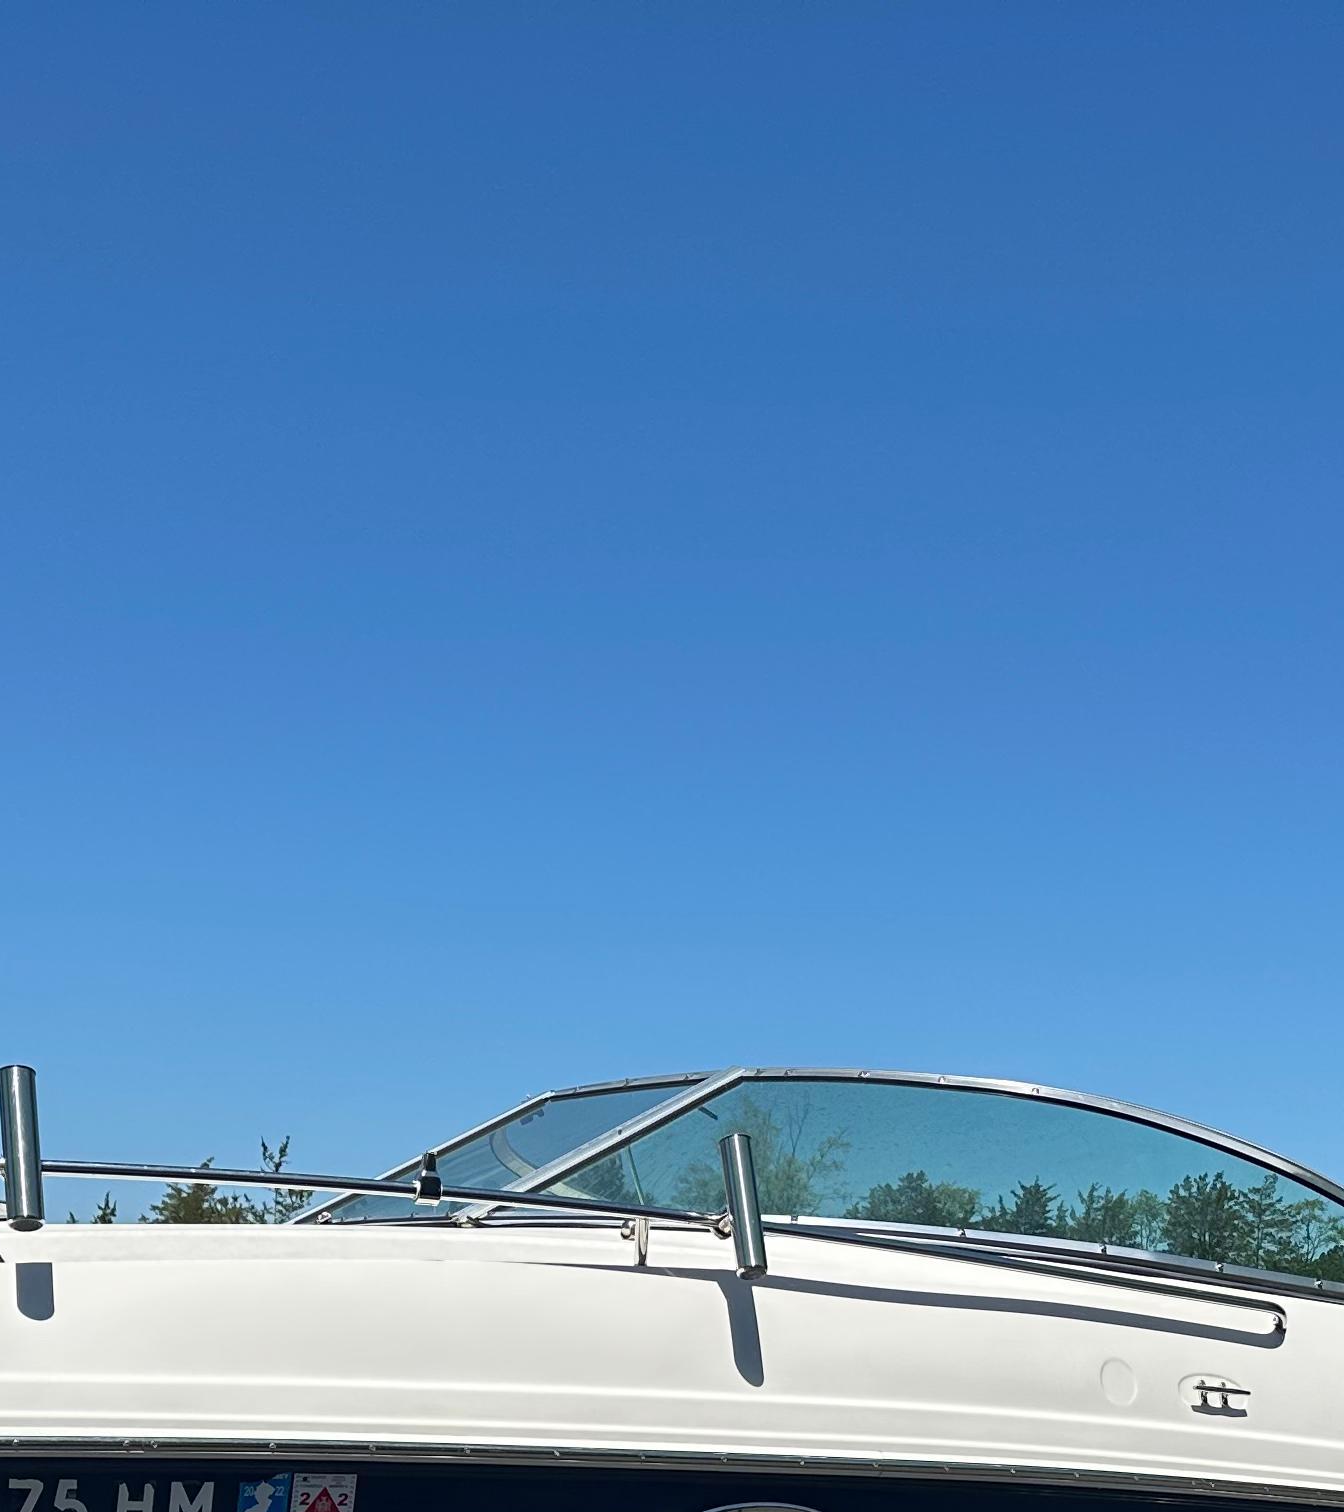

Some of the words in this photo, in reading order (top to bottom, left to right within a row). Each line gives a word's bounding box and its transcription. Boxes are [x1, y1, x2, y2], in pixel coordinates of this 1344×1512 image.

[244, 1486, 254, 1496] 20
[275, 1486, 284, 1496] 22
[299, 1492, 310, 1505] 2
[337, 1493, 348, 1505] 2
